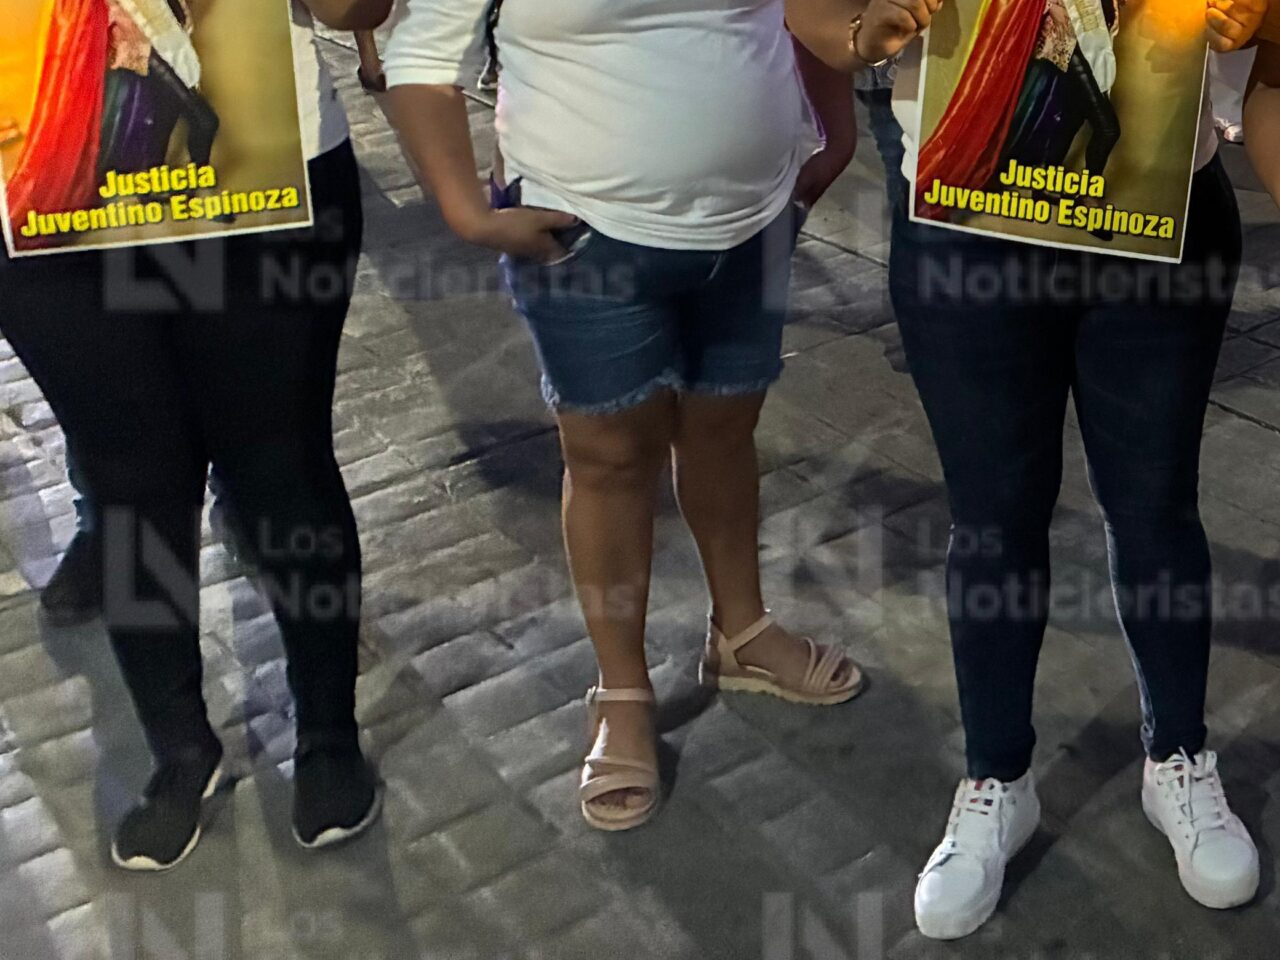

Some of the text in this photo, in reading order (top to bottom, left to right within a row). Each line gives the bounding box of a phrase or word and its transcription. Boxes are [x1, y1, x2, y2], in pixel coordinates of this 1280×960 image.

[99, 161, 216, 199] Justicia
[1000, 158, 1105, 198] Justicia
[20, 197, 163, 237] Juventino
[171, 185, 299, 221] Espinoza
[924, 178, 1175, 239] Juventino Espinoza
